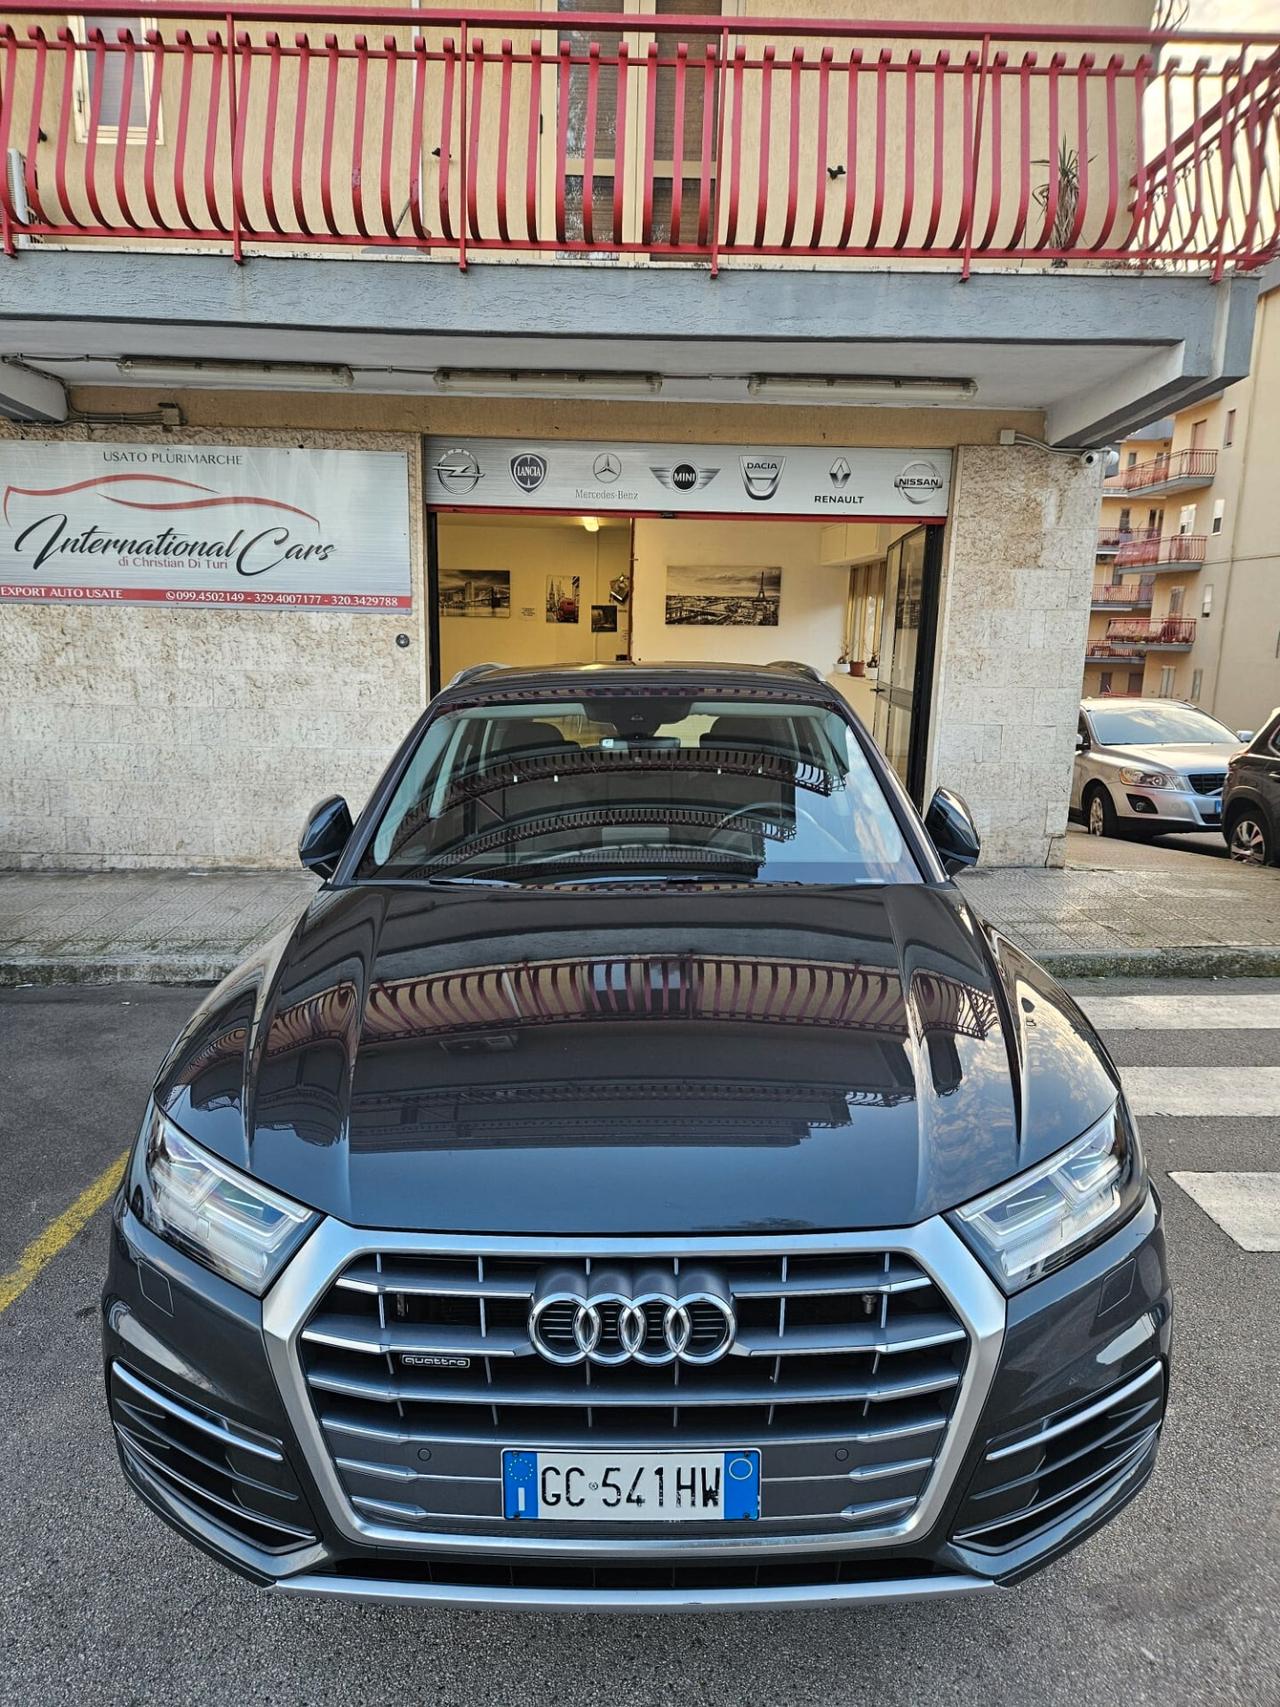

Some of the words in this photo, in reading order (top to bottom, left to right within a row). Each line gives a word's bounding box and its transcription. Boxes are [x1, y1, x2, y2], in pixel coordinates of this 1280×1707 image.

[103, 451, 148, 463] USATO
[151, 452, 243, 465] PLURIMARCHE
[517, 466, 541, 477] LANCIA
[746, 462, 778, 470] DACIA
[673, 472, 696, 482] MINI
[898, 478, 940, 487] NISSAN
[575, 488, 639, 500] Mercedes-Benz
[814, 495, 864, 504] RENAULT
[14, 513, 245, 570] International
[236, 526, 337, 576] Cars
[118, 557, 129, 567] di
[132, 557, 185, 568] Christian
[188, 558, 202, 568] Di
[205, 559, 228, 569] Turi
[1, 586, 47, 597] EXPORT
[49, 588, 86, 598] AUTO
[86, 589, 123, 598] USATE
[176, 591, 245, 602] 099.4502149
[254, 593, 321, 605] 329.4007177
[331, 595, 398, 606] 320.3429788
[405, 1357, 466, 1366] quattro
[541, 1467, 585, 1507] GC
